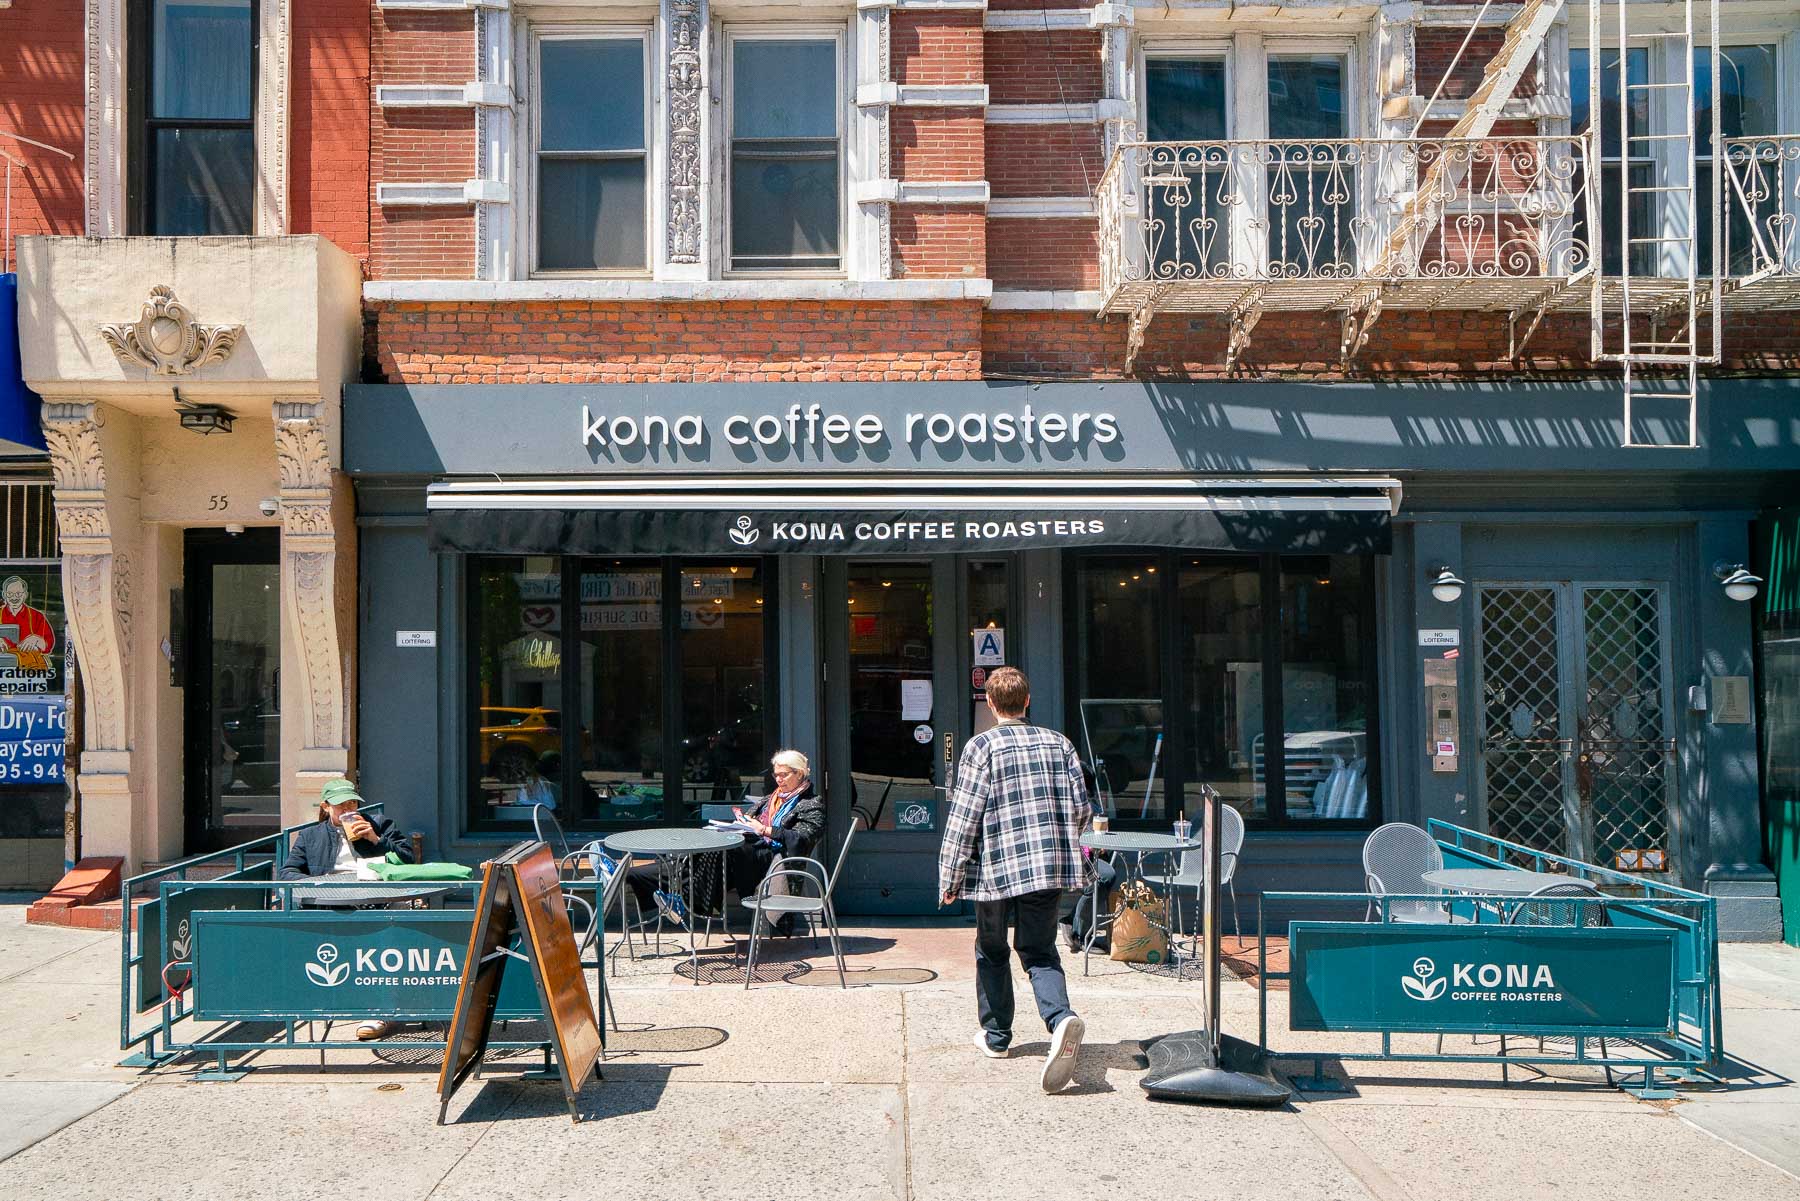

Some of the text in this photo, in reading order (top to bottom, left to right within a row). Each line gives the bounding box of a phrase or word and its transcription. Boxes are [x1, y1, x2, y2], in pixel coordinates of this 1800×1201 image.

[582, 403, 1118, 445] kona coffee roasters
[208, 495, 228, 511] 55
[772, 519, 1105, 540] KONA COFFEE ROASTERS
[980, 633, 999, 655] A
[1, 705, 36, 738] Dry
[356, 947, 458, 973] KONA
[354, 976, 399, 986] COFFEE
[1453, 963, 1555, 988] KONA
[1451, 991, 1563, 1002] COFFEE ROASTERS
